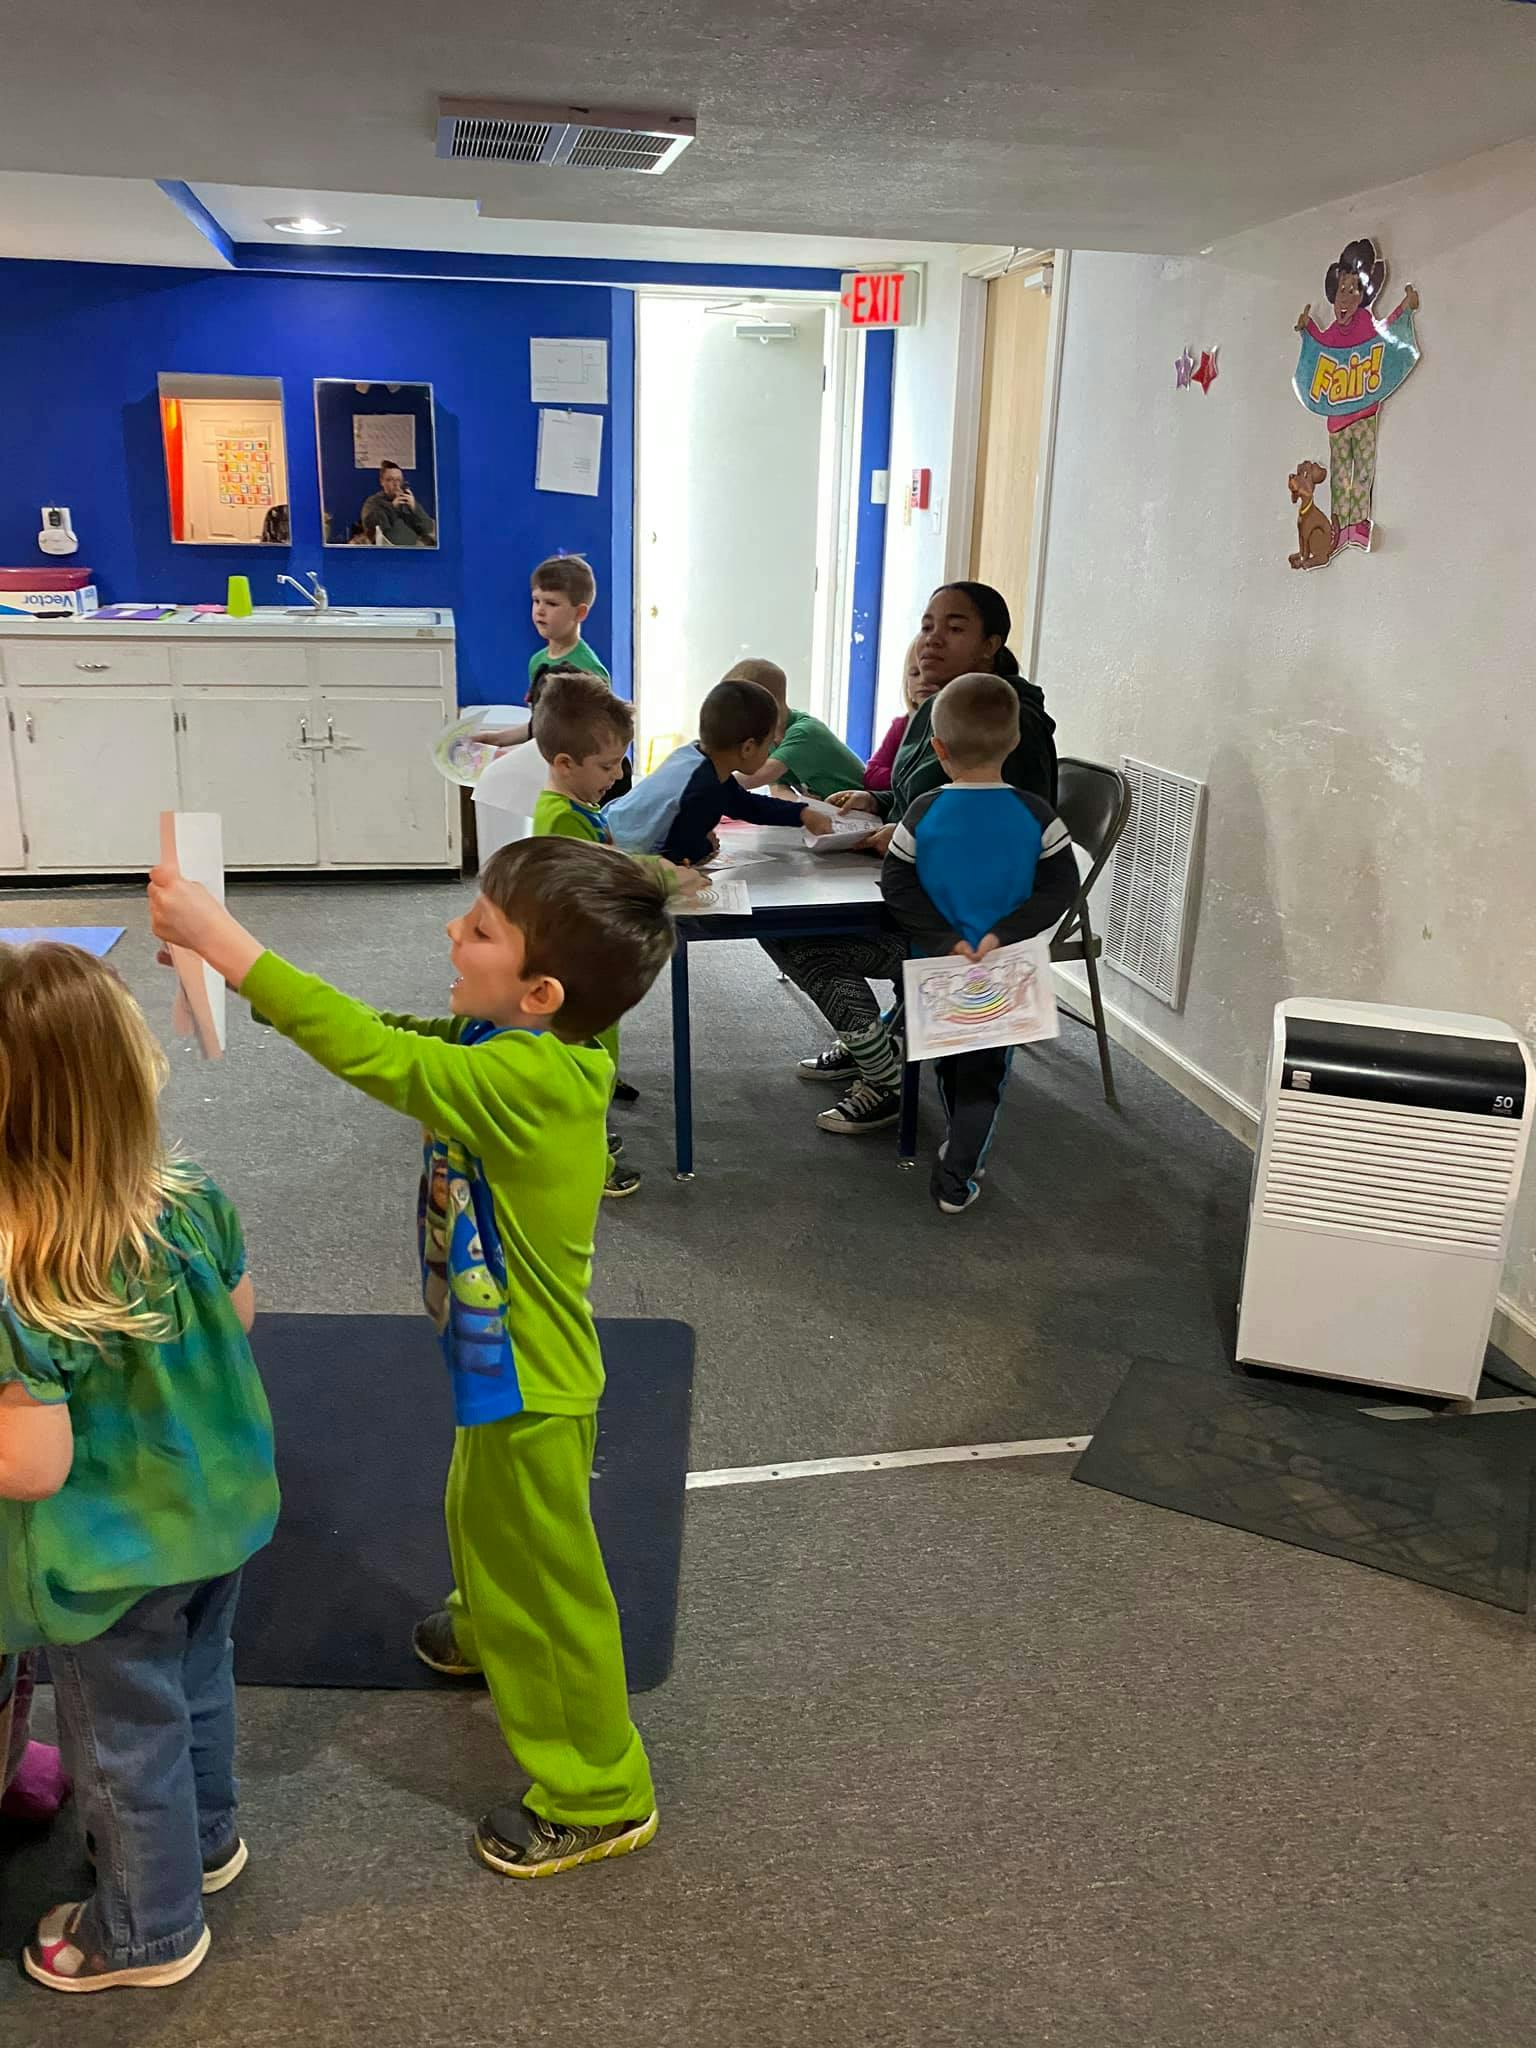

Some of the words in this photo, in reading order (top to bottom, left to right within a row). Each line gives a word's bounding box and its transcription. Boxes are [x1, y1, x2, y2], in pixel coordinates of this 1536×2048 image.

[852, 273, 904, 324] EXIT
[1310, 343, 1384, 404] Fair!
[23, 594, 74, 608] Vector
[1493, 1095, 1514, 1109] 50
